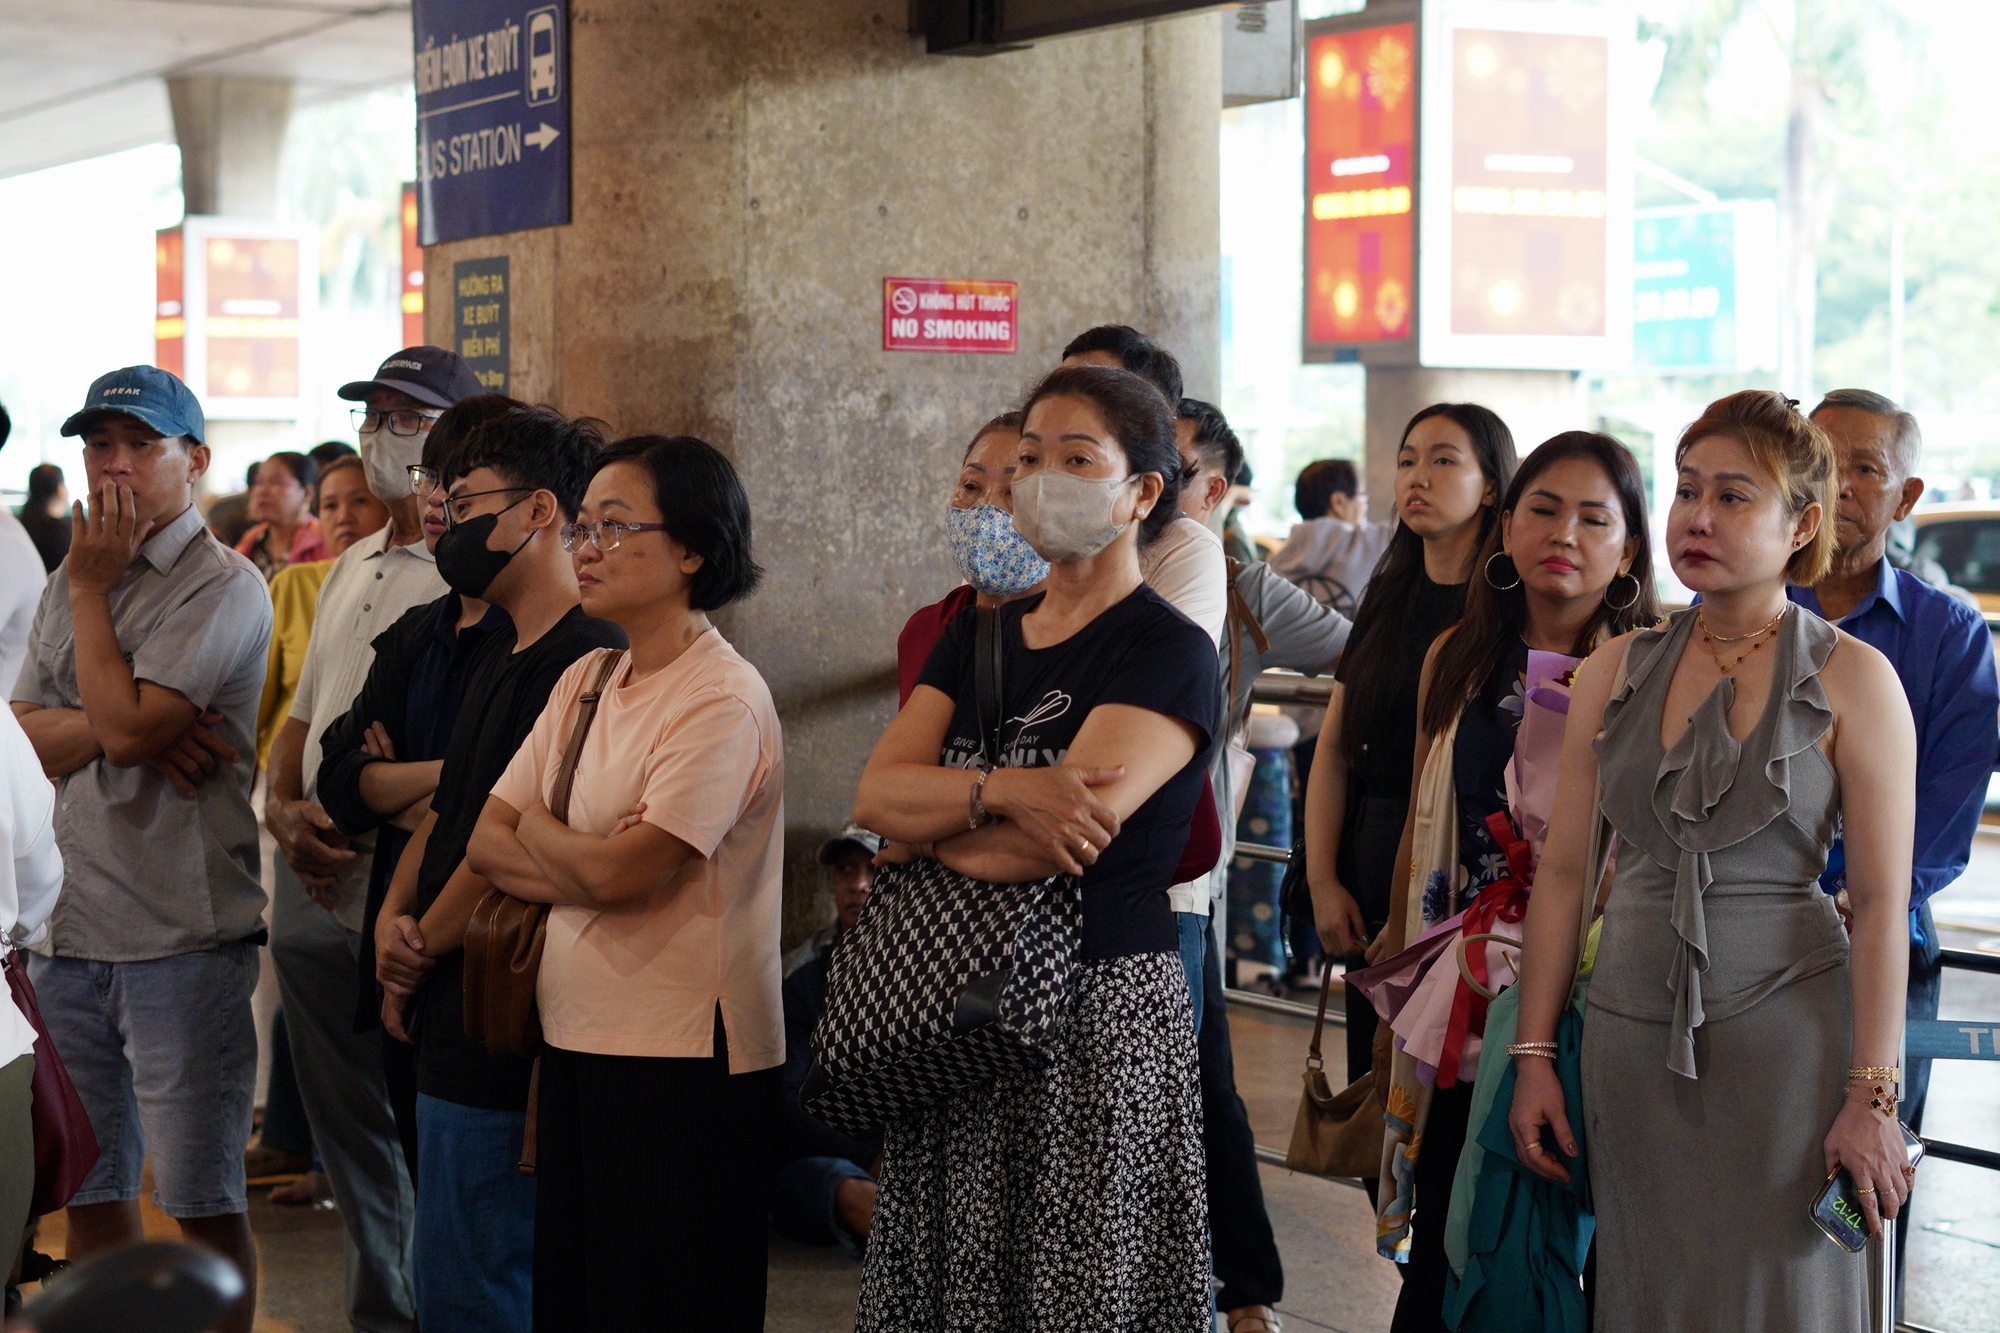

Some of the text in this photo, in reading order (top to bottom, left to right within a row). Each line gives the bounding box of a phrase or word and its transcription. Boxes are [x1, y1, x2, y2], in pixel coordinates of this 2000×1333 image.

[467, 34, 486, 82] XE
[486, 18, 520, 77] BUÝT
[448, 121, 521, 176] STATION
[891, 317, 1011, 341] NO SMOKING
[103, 387, 141, 397] BREAK
[953, 737, 976, 749] GIVE
[1020, 735, 1040, 745] DAY
[1832, 1195, 1862, 1229] 17:12
